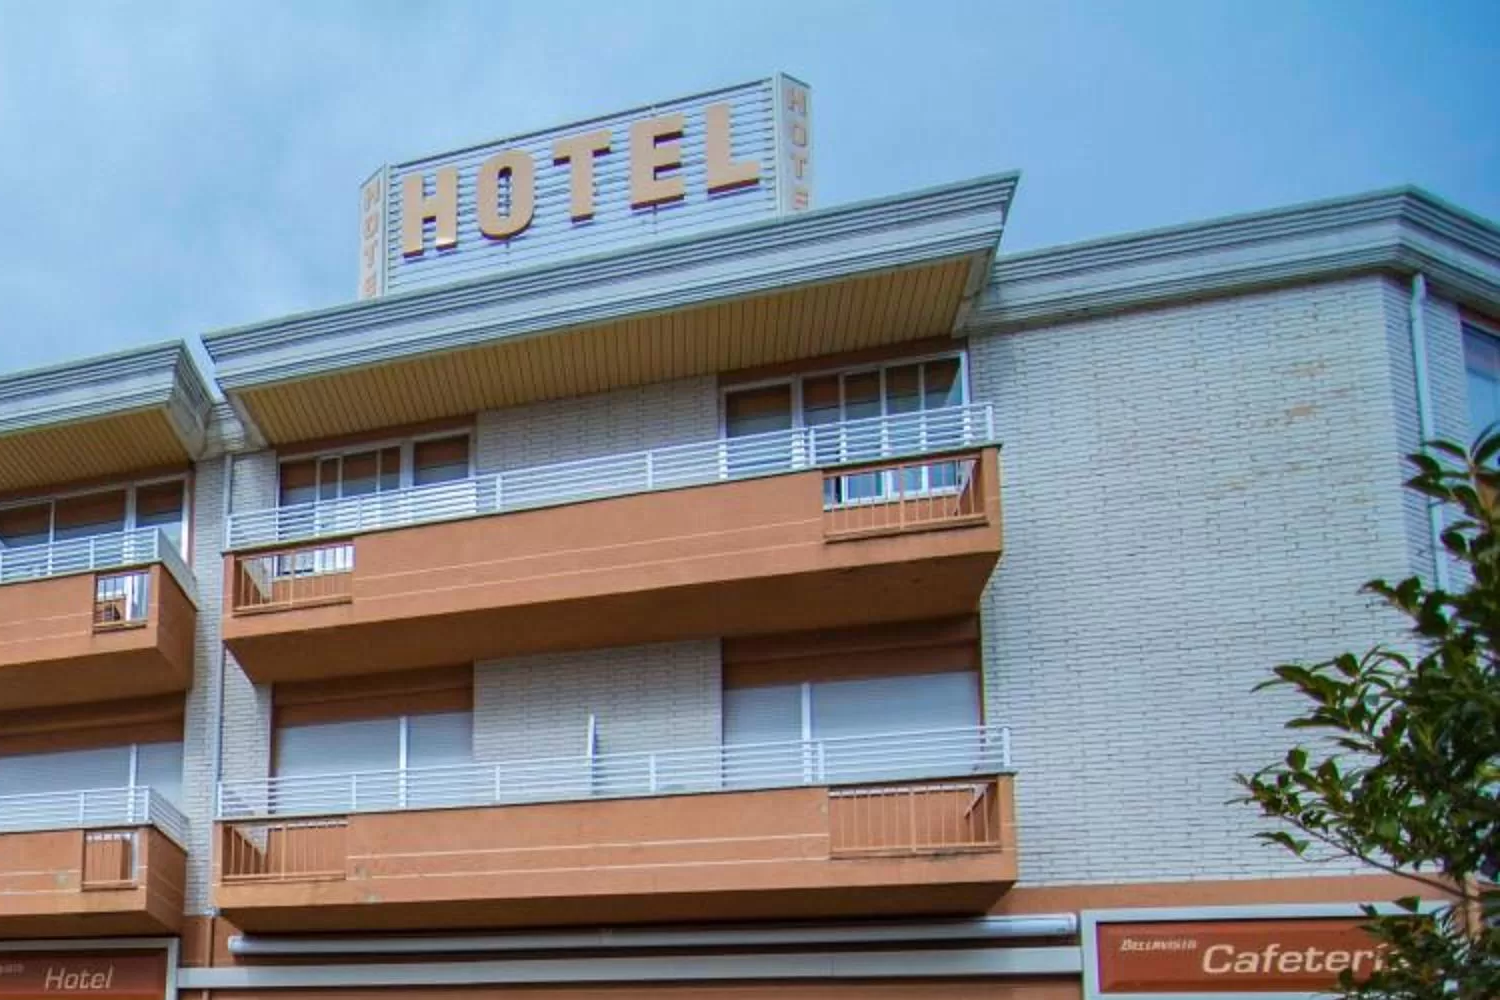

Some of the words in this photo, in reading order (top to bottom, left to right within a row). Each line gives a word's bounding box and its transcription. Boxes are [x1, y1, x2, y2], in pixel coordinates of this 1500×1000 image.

[402, 103, 760, 258] HOTEL
[786, 87, 809, 211] HOTE
[45, 965, 114, 990] Hotel
[1202, 943, 1410, 974] Cafeterí
